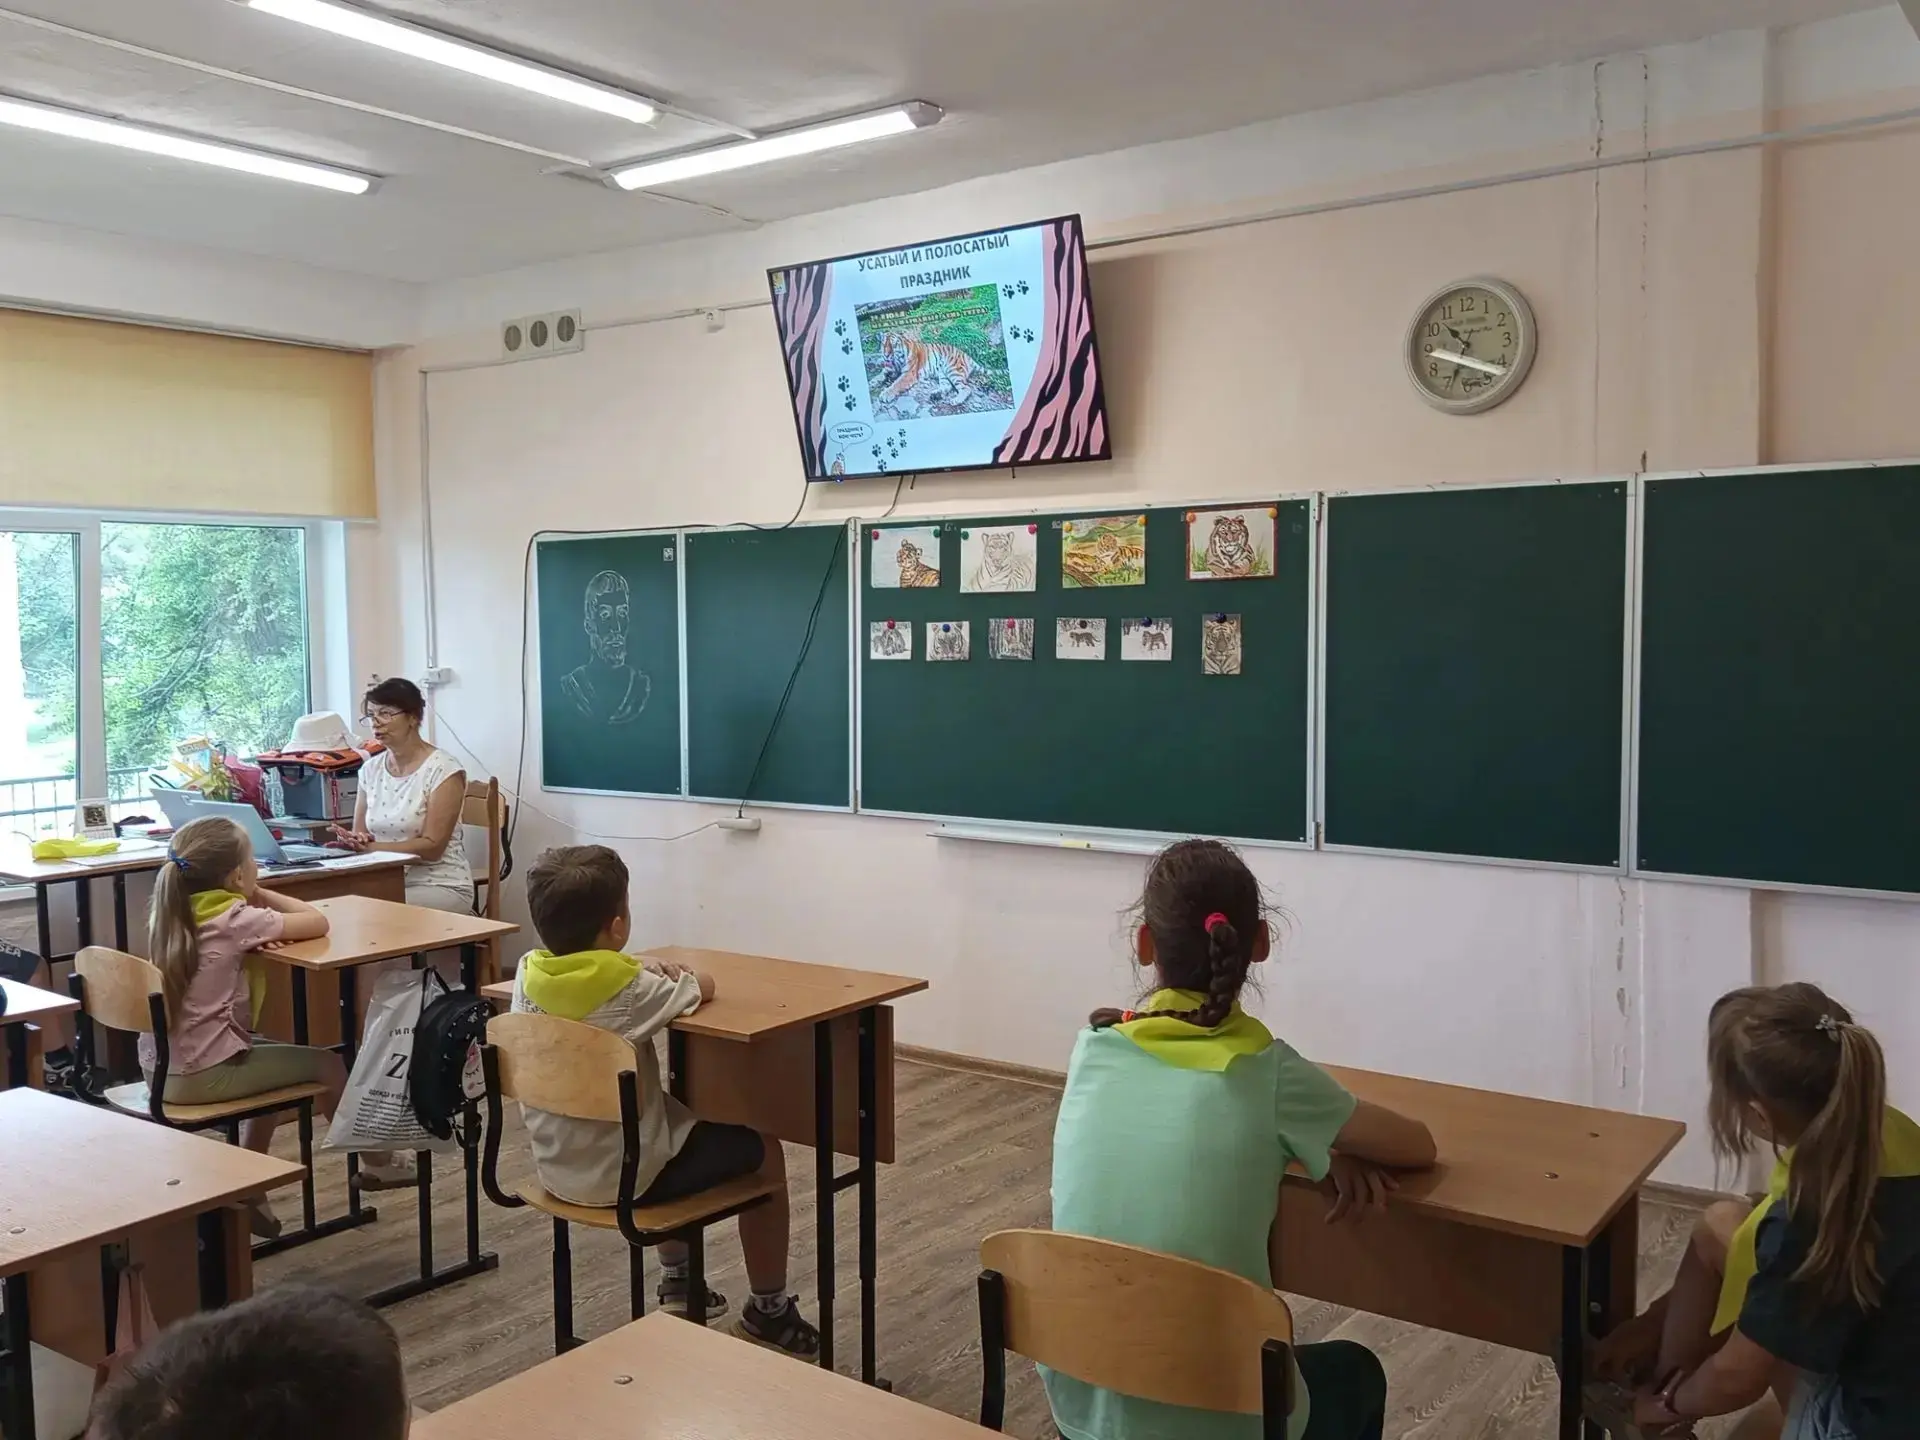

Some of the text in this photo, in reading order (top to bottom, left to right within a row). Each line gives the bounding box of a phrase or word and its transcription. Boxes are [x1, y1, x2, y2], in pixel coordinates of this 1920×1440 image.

[857, 231, 1010, 273] УСАТЫЙ И ПОЛОСАТЫЙ
[899, 265, 972, 289] ПРАЗДНИК
[1460, 296, 1475, 312] 12
[1483, 299, 1489, 314] 1
[1441, 305, 1453, 320] 11
[1497, 312, 1506, 327] 2
[1426, 322, 1440, 337] 10
[1502, 331, 1511, 347] 3
[1496, 354, 1507, 368] 4
[1429, 362, 1438, 377] 8
[1442, 376, 1452, 390] 7
